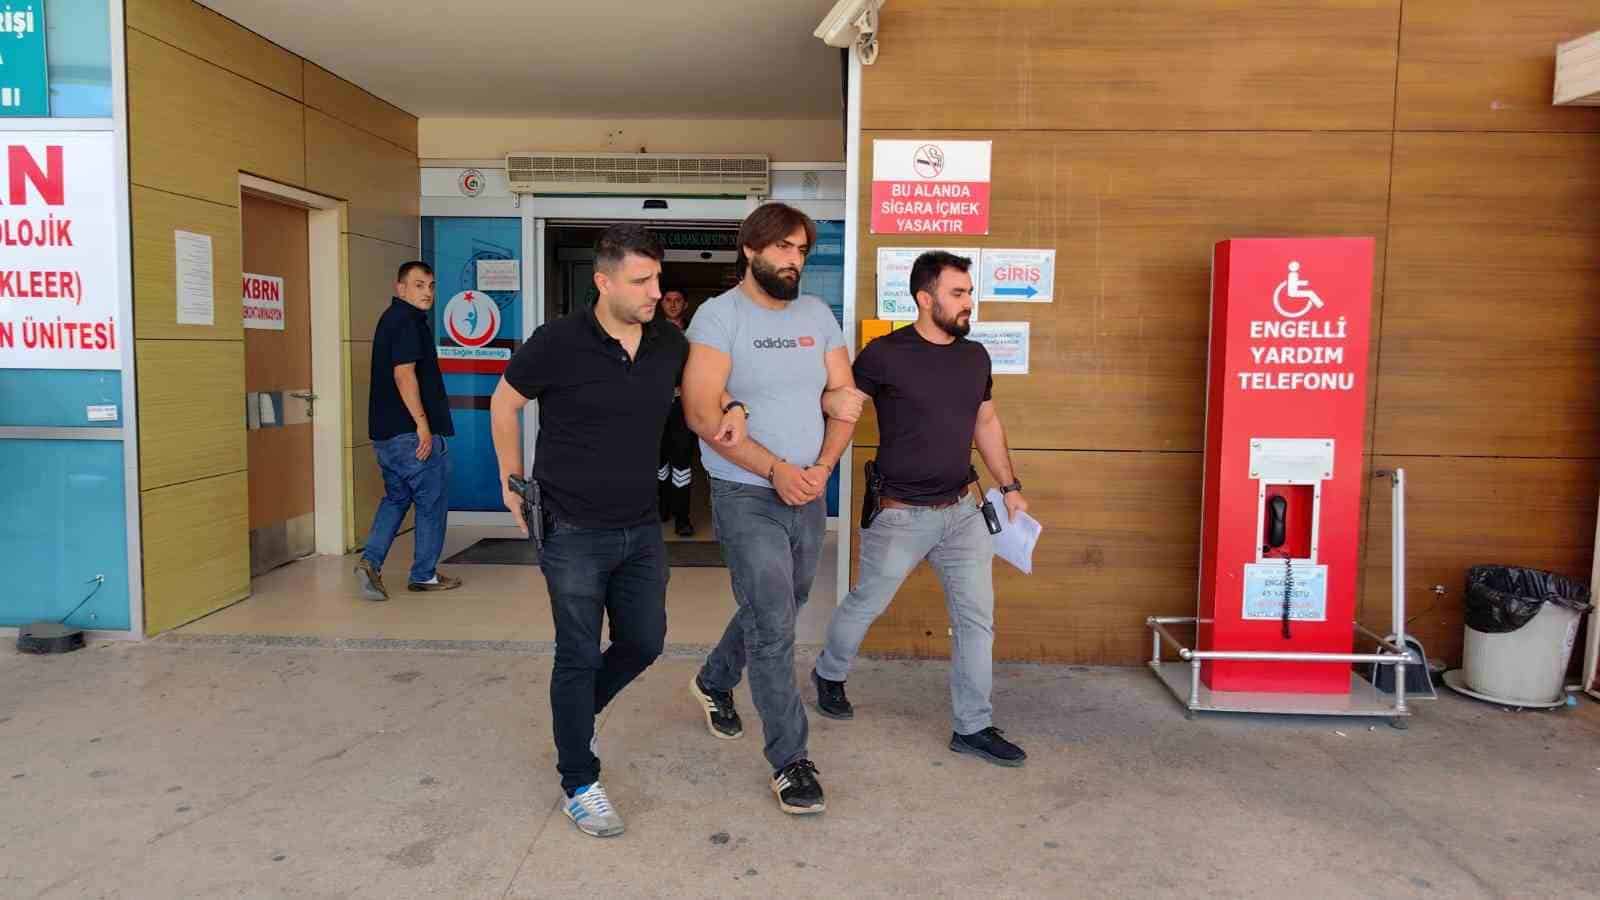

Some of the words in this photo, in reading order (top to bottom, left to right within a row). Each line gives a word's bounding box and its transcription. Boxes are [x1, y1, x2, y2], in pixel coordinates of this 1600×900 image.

[0, 145, 64, 205] N
[892, 183, 911, 197] BU
[914, 184, 970, 198] ALANDA
[881, 199, 933, 215] SİGARA
[936, 200, 979, 218] İÇMEK
[0, 213, 73, 246] LOJİK
[896, 218, 963, 233] YASAKTIR
[994, 263, 1041, 286] GİRİŞ
[0, 271, 81, 306] KLEER)
[242, 277, 279, 302] KBRN
[22, 315, 115, 350] ÜNİTESİ
[1250, 316, 1347, 338] ENGELLİ
[753, 336, 797, 349] adidas
[1250, 346, 1344, 365] YARDIM
[1238, 371, 1355, 390] TELEFONU
